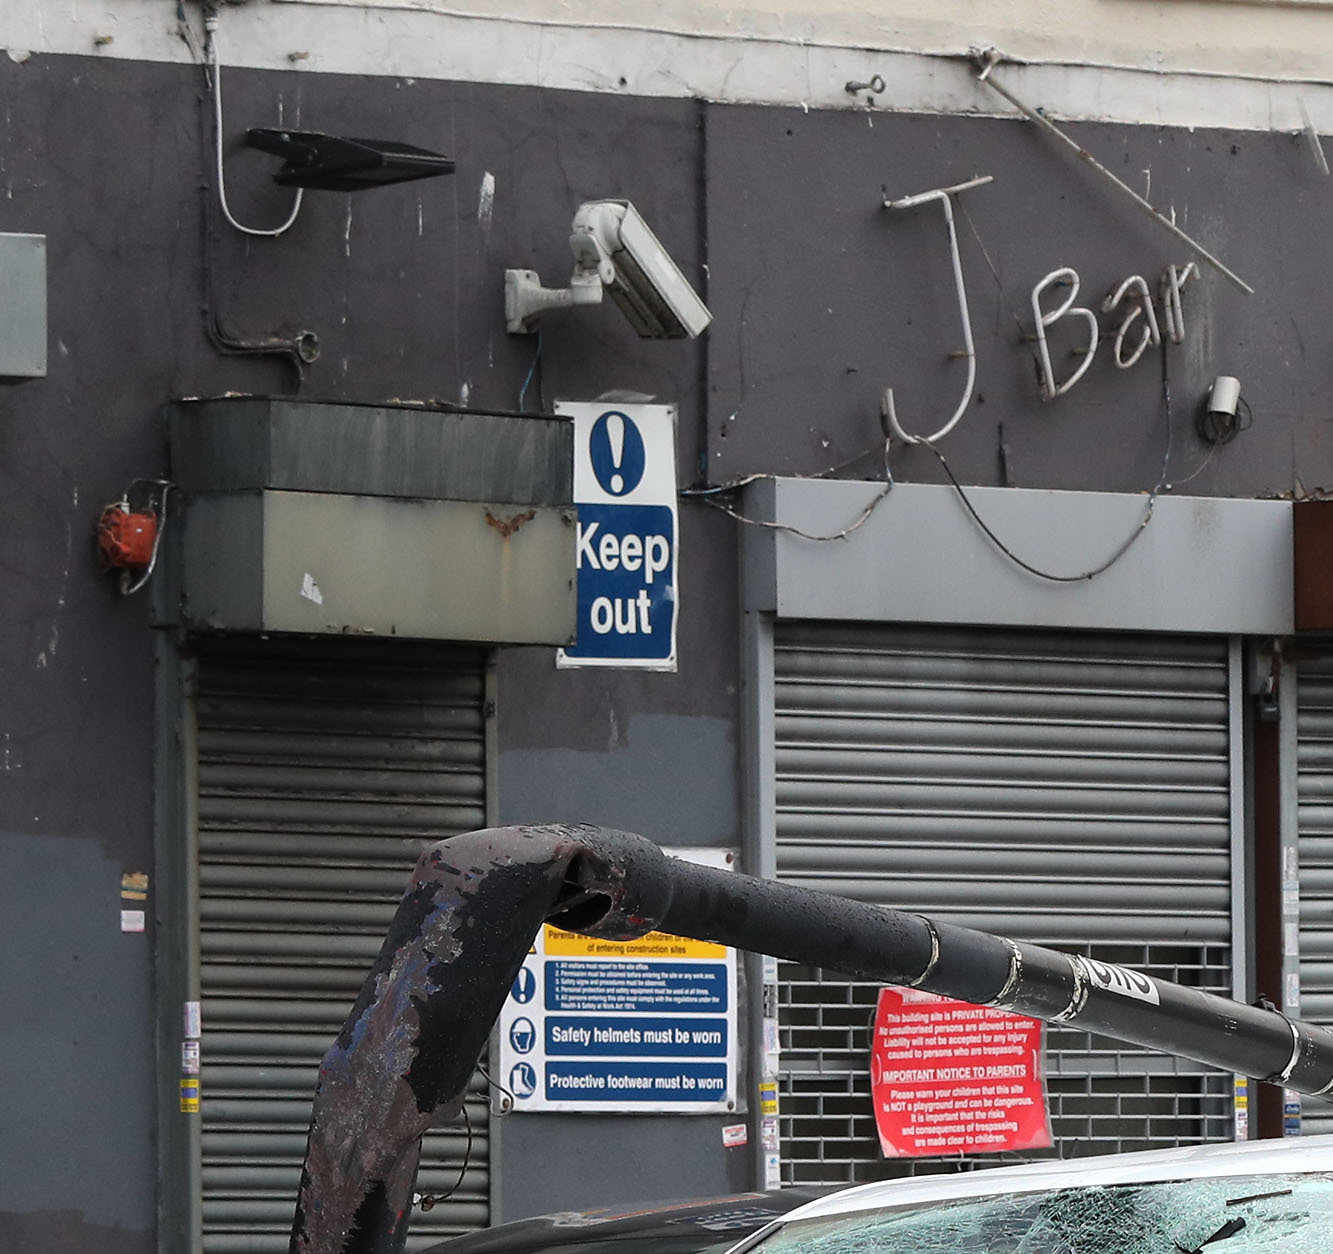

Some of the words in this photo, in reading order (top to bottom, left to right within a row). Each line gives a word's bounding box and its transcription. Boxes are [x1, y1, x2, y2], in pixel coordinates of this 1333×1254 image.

[1032, 261, 1201, 399] Bar
[576, 521, 670, 584] Keep
[590, 589, 653, 635] out
[587, 944, 595, 952] of
[596, 945, 625, 955] entering
[626, 945, 669, 953] construction
[670, 946, 687, 954] sites
[888, 1013, 900, 1023] This
[901, 1012, 929, 1024] building
[930, 1012, 943, 1021] site
[944, 1011, 951, 1020] is
[952, 1009, 985, 1020] PRIVATE
[879, 1026, 888, 1035] No
[889, 1024, 934, 1035] unauthorised
[934, 1024, 964, 1035] persons
[965, 1023, 977, 1032] are
[979, 1021, 1005, 1031] allowed
[1005, 1021, 1013, 1030] to
[1014, 1020, 1035, 1030] enter.
[552, 1026, 591, 1046] Safety
[594, 1027, 641, 1043] helmets
[643, 1028, 673, 1044] must
[675, 1028, 690, 1044] be
[692, 1031, 722, 1044] worn
[550, 1073, 605, 1089] Protective
[607, 1074, 653, 1089] footwear
[654, 1075, 681, 1089] must
[682, 1075, 696, 1089] be
[697, 1078, 724, 1089] worn
[883, 1069, 935, 1083] IMPORTANT
[936, 1067, 971, 1081] NOTICE
[973, 1066, 985, 1078] TO
[986, 1064, 1027, 1077] PARENTS
[890, 1089, 915, 1099] Please
[915, 1090, 934, 1099] warn
[934, 1089, 951, 1100] your
[952, 1086, 981, 1096] children
[981, 1085, 996, 1095] that
[996, 1084, 1009, 1094] this
[1010, 1084, 1024, 1094] site
[883, 1102, 890, 1112] is
[890, 1101, 907, 1112] NOT
[907, 1103, 913, 1111] a
[913, 1100, 953, 1112] playground
[955, 1098, 969, 1108] and
[969, 1099, 983, 1108] can
[983, 1097, 993, 1107] be
[993, 1097, 1034, 1108] dangerous.
[911, 1113, 917, 1123] It
[917, 1112, 924, 1122] is
[925, 1112, 959, 1124] important
[960, 1111, 974, 1120] that
[975, 1110, 987, 1119] the
[987, 1109, 1005, 1119] risks
[915, 1138, 926, 1147] are
[927, 1137, 947, 1146] made
[947, 1136, 965, 1145] clear
[965, 1135, 974, 1144] to
[975, 1134, 1008, 1143] children.
